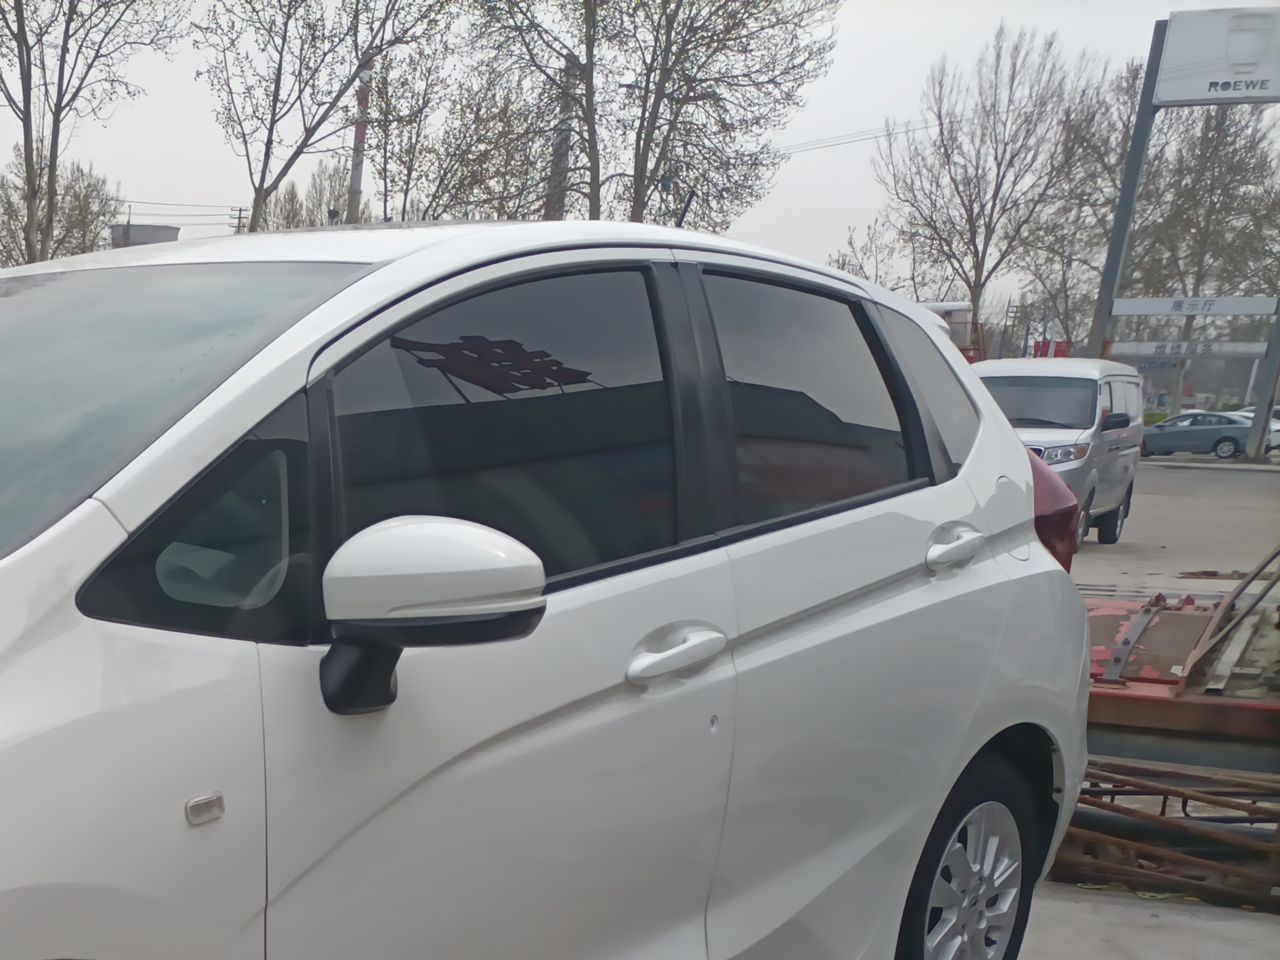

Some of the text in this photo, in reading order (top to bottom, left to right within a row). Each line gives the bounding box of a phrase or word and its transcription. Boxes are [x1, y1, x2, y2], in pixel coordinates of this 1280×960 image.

[1207, 79, 1271, 92] ROEWE
[1171, 299, 1216, 313] 展示厅
